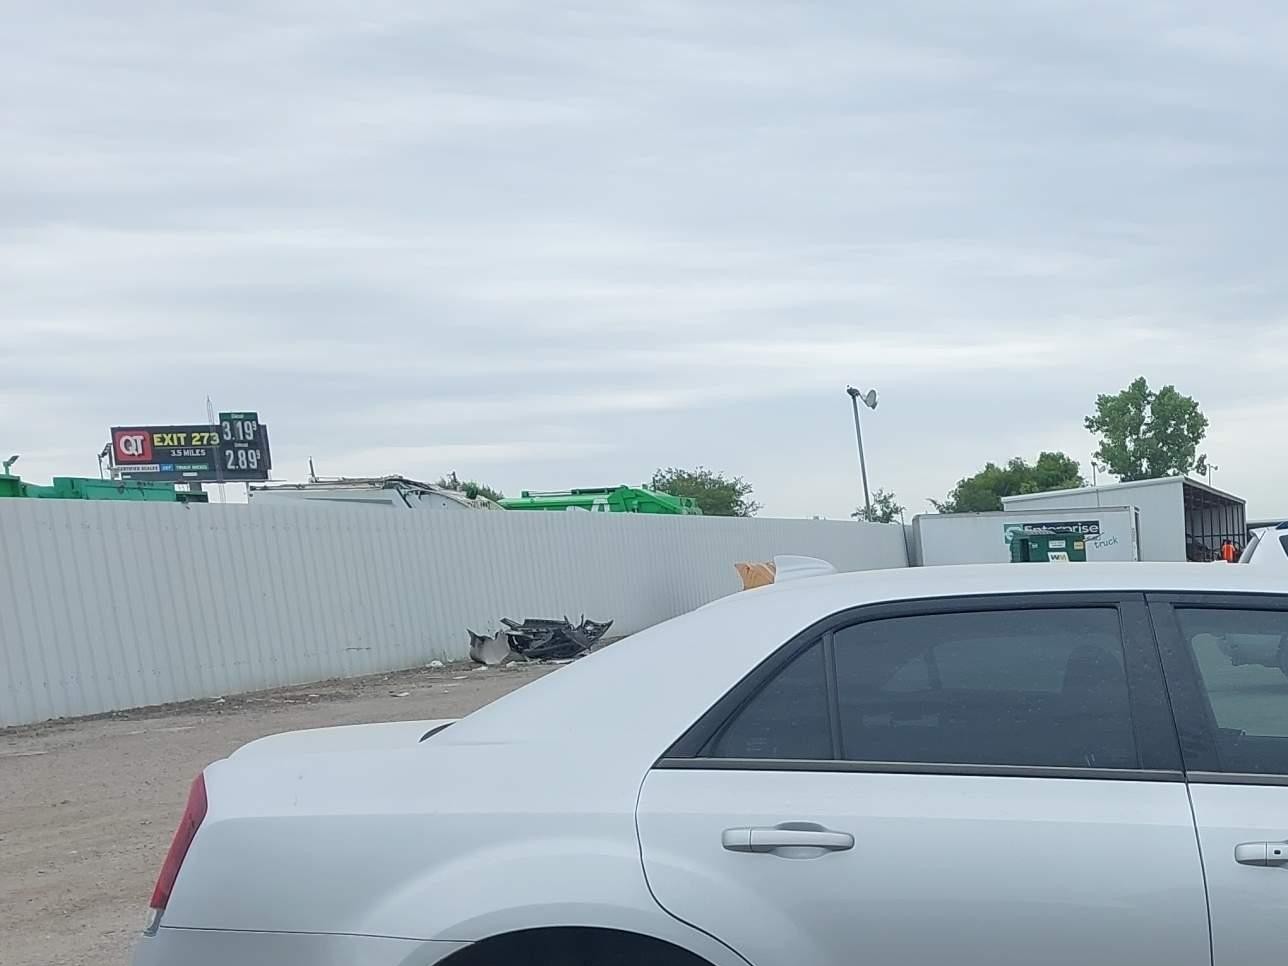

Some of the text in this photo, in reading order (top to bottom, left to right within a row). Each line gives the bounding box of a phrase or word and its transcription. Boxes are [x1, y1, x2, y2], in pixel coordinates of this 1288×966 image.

[153, 432, 220, 446] EXIT 273
[119, 435, 144, 457] QT
[185, 449, 206, 457] MILES
[1094, 537, 1119, 548] truck
